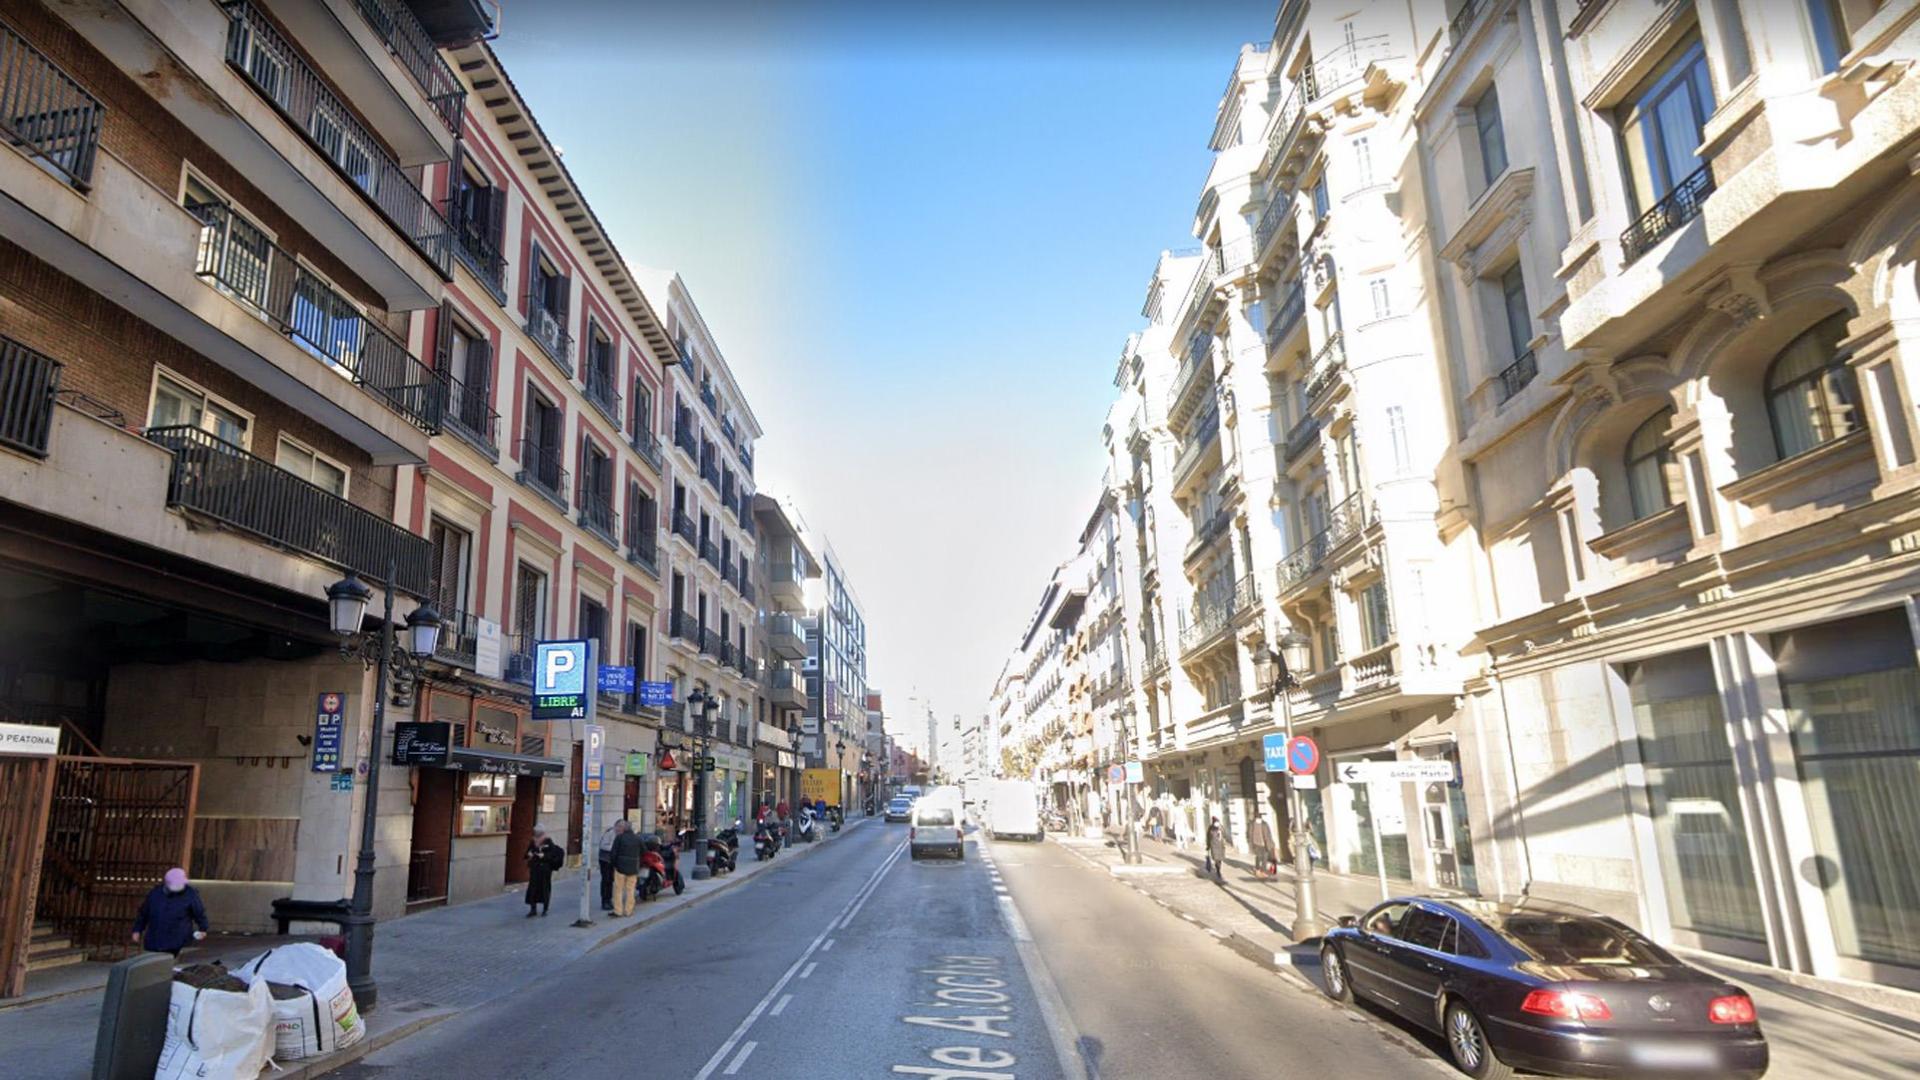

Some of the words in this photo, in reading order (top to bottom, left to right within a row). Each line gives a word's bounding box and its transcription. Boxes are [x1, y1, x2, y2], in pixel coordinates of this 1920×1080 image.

[545, 650, 575, 688] P
[540, 696, 578, 708] LIBRE
[7, 734, 56, 746] PEATONAL
[1265, 746, 1286, 759] TAXI
